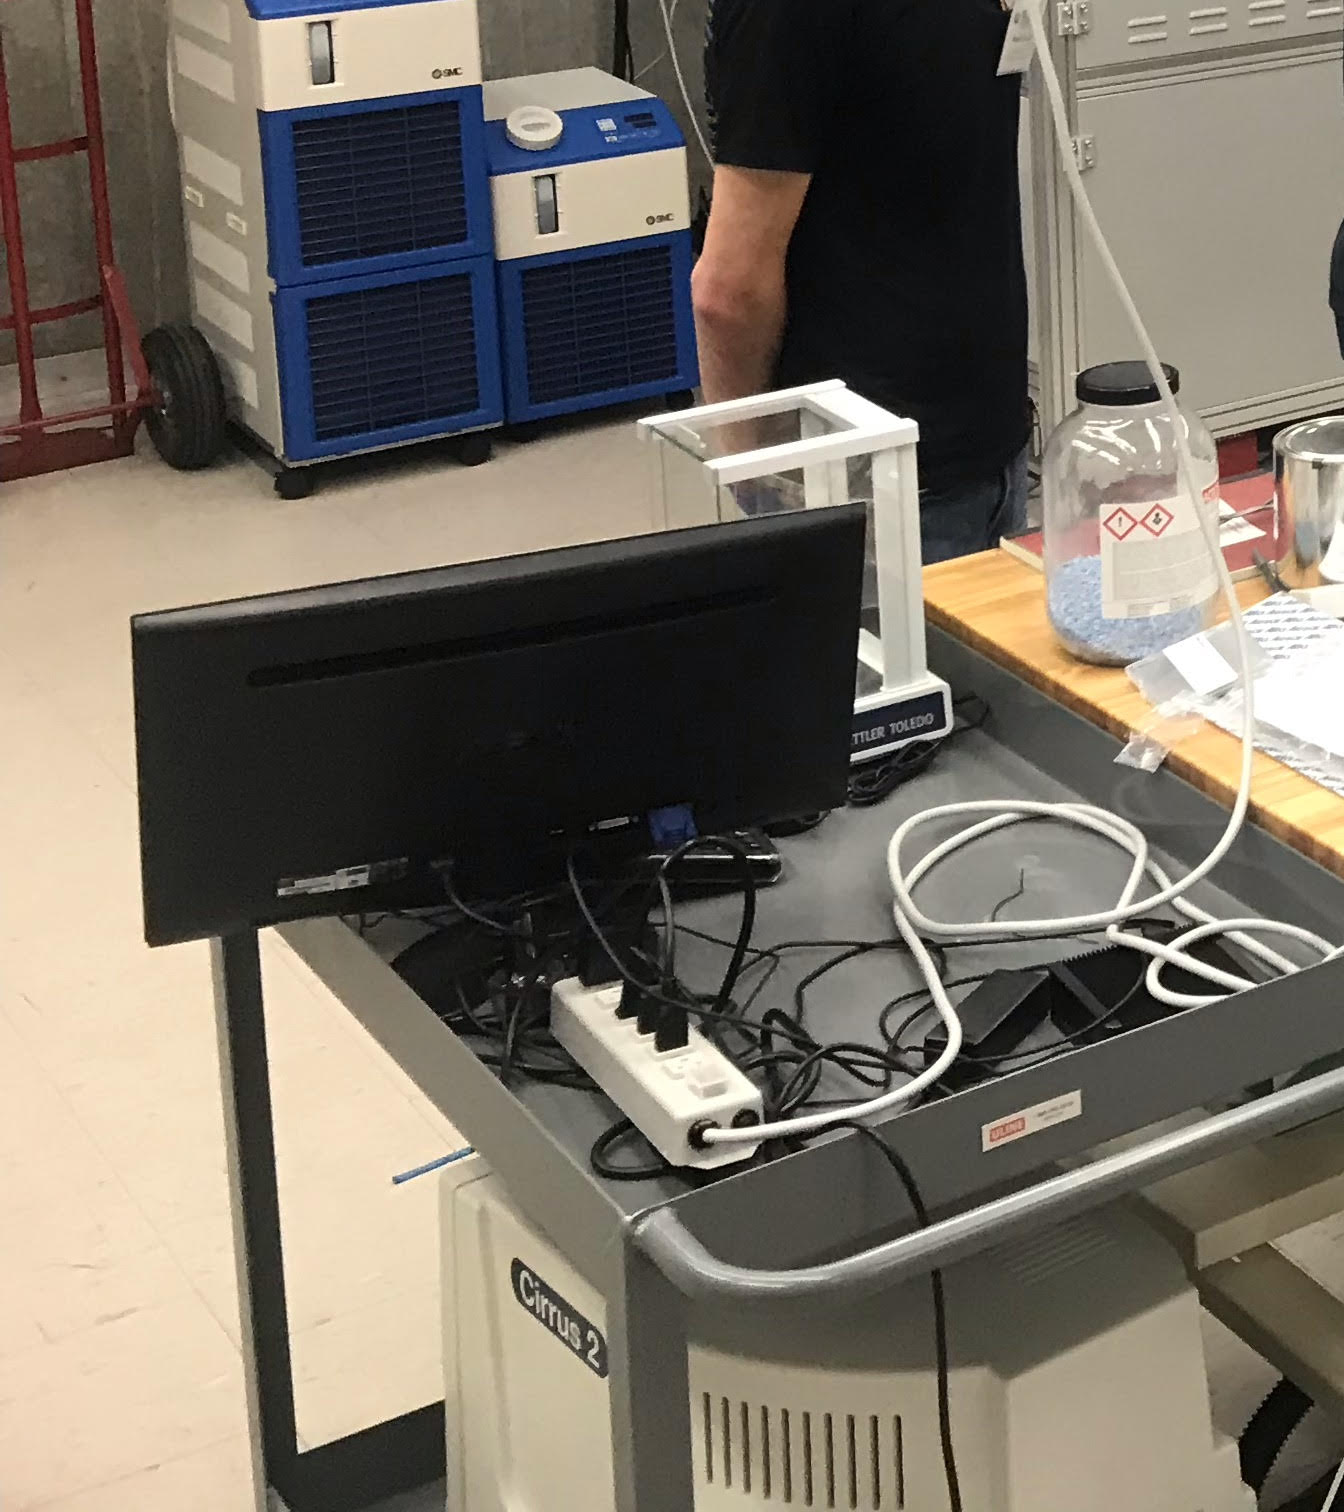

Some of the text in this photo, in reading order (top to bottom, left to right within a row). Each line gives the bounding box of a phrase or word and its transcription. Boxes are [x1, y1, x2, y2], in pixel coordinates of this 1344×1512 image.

[851, 712, 935, 745] TTLER TOLEDO
[519, 1269, 601, 1369] Cirrus 2
